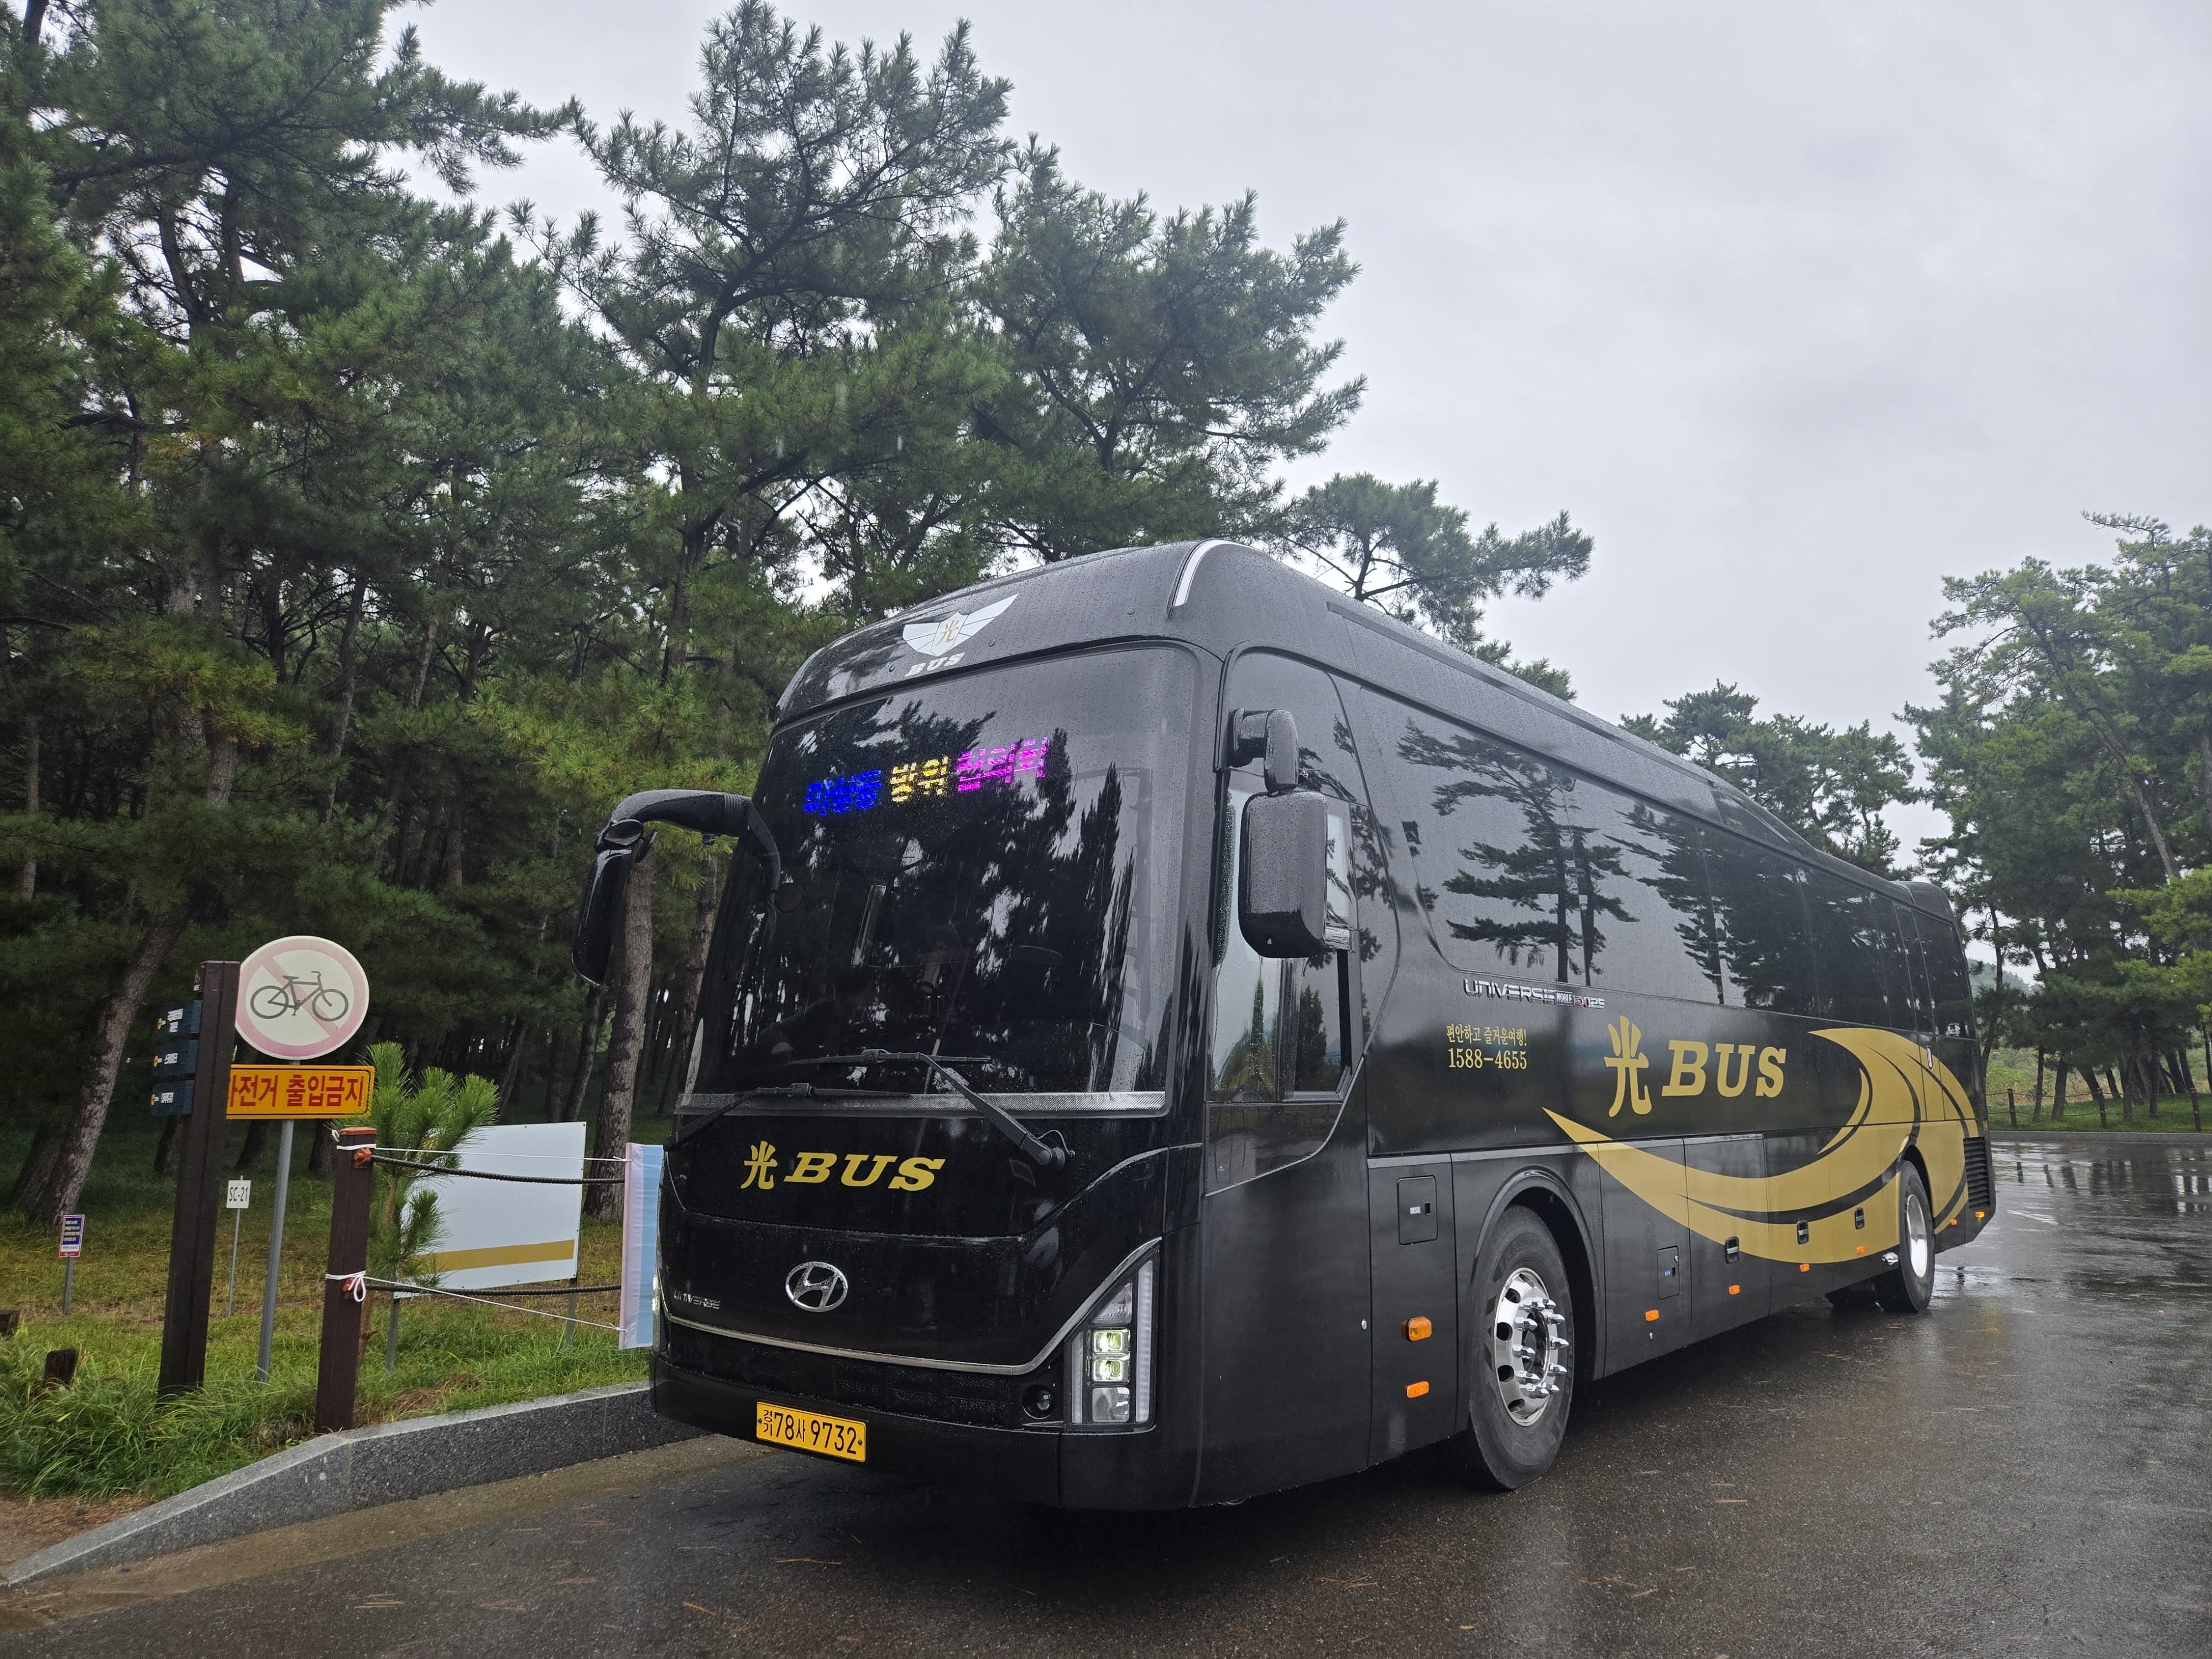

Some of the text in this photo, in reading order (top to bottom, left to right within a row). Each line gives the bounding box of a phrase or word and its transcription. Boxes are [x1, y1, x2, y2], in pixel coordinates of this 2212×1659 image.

[935, 620, 959, 646] 光
[905, 653, 966, 677] BUS
[1463, 979, 1555, 1004] UNIVERSE
[1446, 1023, 1481, 1044] 편안하고
[1448, 1047, 1527, 1070] 1588-4655
[1661, 1040, 1787, 1098] BUS
[286, 1074, 364, 1108] 출입금지
[784, 1152, 946, 1191] BUS
[229, 1186, 248, 1202] SC-21
[810, 1419, 857, 1455] 9732
